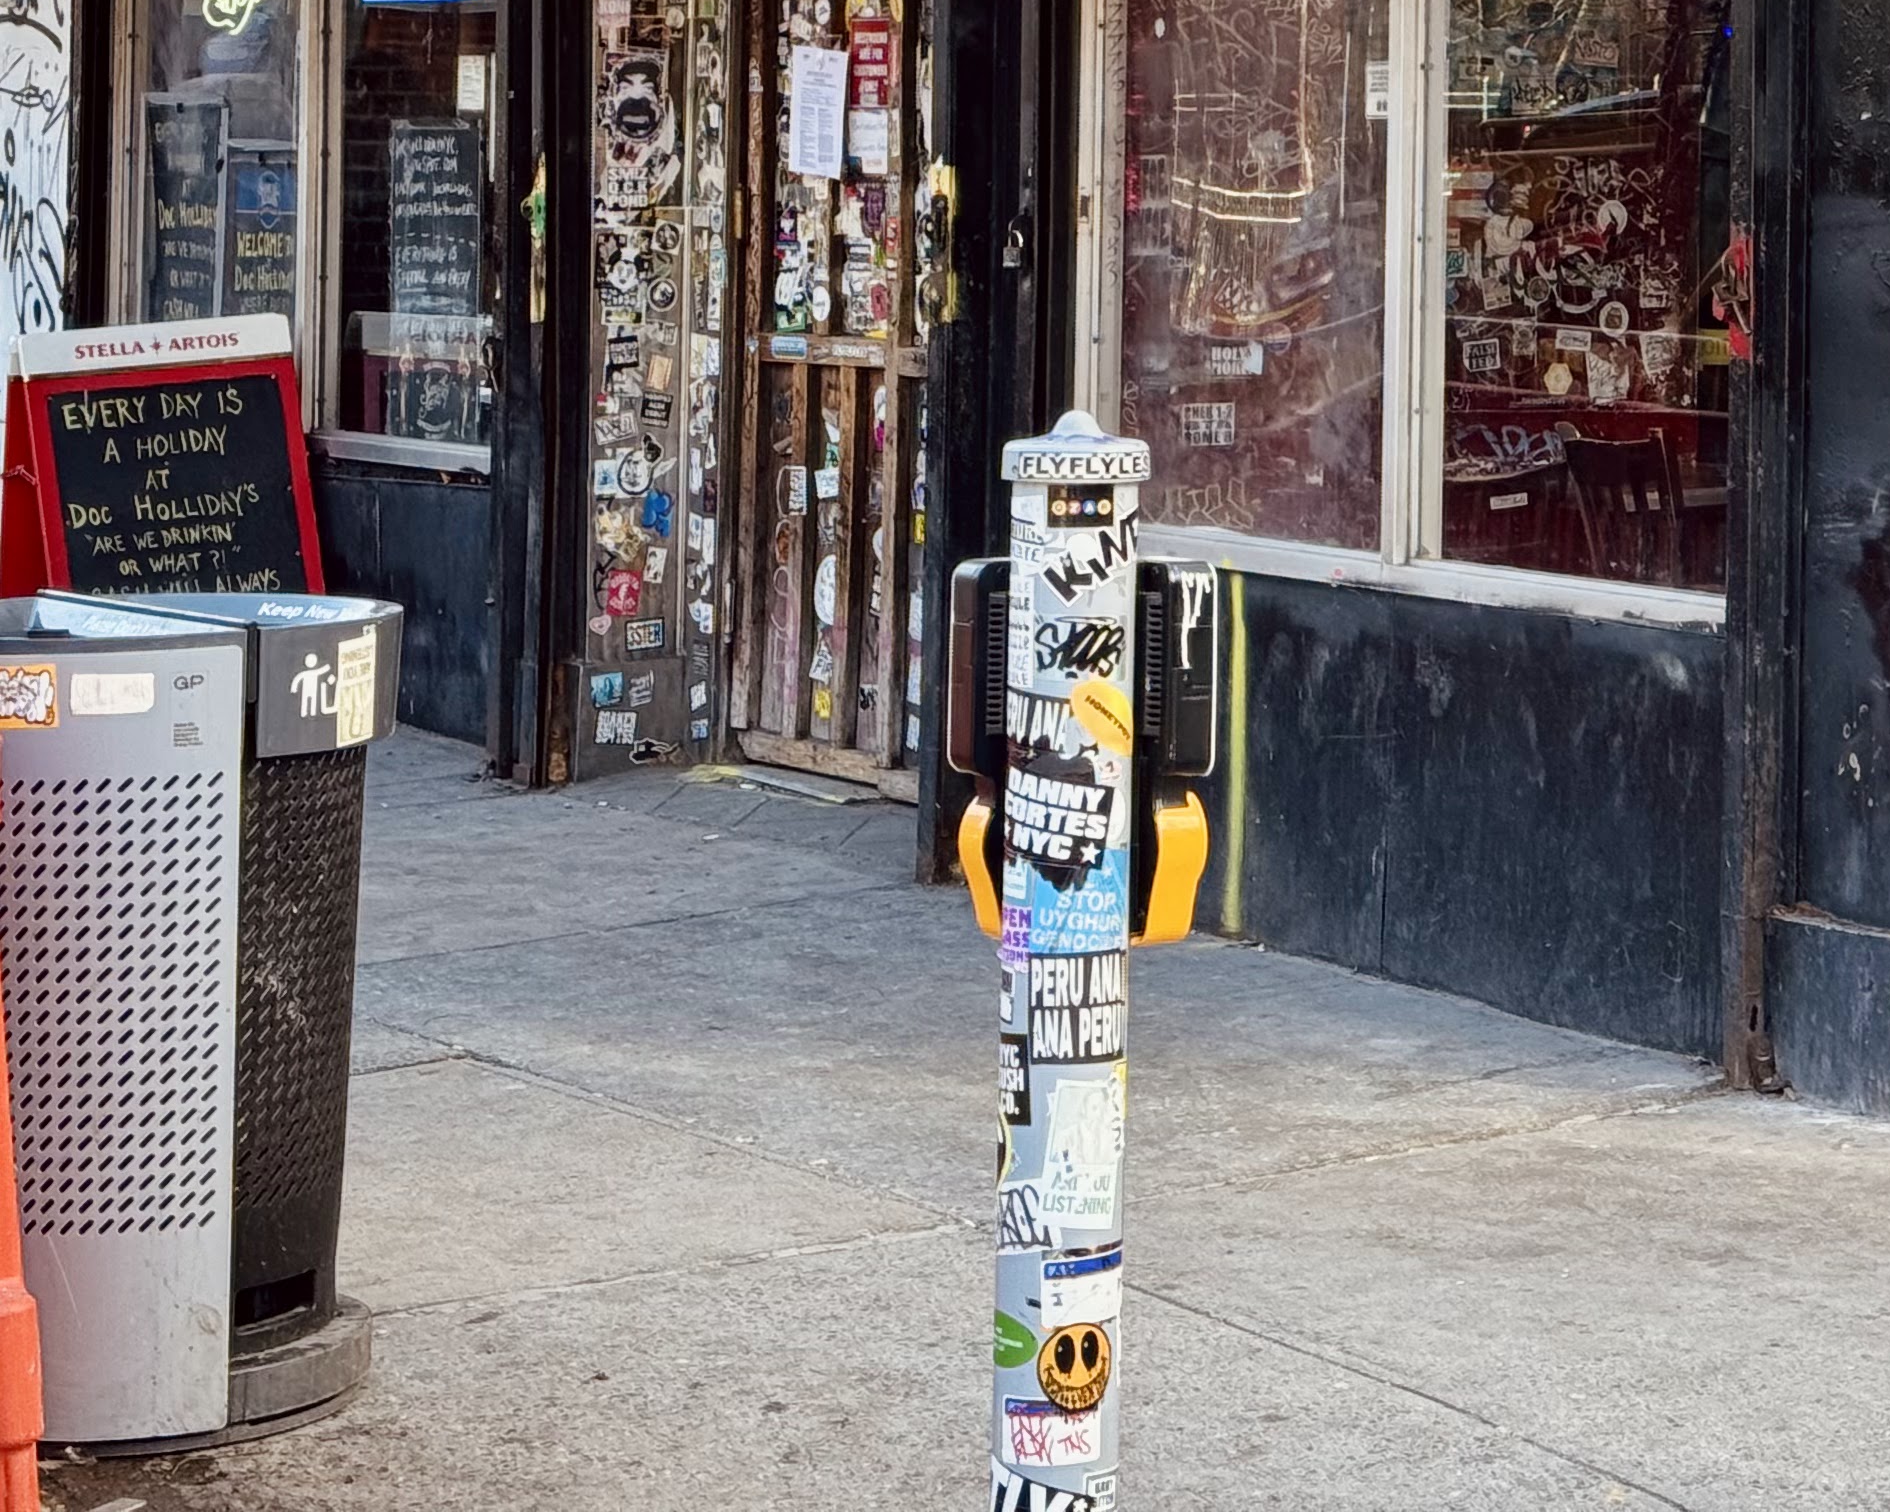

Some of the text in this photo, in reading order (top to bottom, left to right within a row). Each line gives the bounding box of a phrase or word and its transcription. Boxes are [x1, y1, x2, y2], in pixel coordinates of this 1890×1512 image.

[237, 231, 284, 258] WELCOME
[74, 333, 240, 360] STELLA ARTOIS
[61, 386, 243, 432] EVERY DAY IS
[103, 424, 228, 464] A HOLIDAY
[145, 468, 170, 491] AT
[133, 532, 159, 551] WE
[118, 558, 142, 577] OR
[149, 551, 202, 574] WHAT
[258, 602, 304, 620] Keep
[1007, 765, 1106, 813] DANNY
[1004, 788, 1108, 840] CORTES
[1012, 823, 1074, 861] NYC
[1056, 890, 1117, 913] STOP
[1039, 910, 1121, 932] UYGHUR
[1031, 952, 1121, 1008] PERU ANA
[1032, 1002, 1122, 1060] ANA PERU
